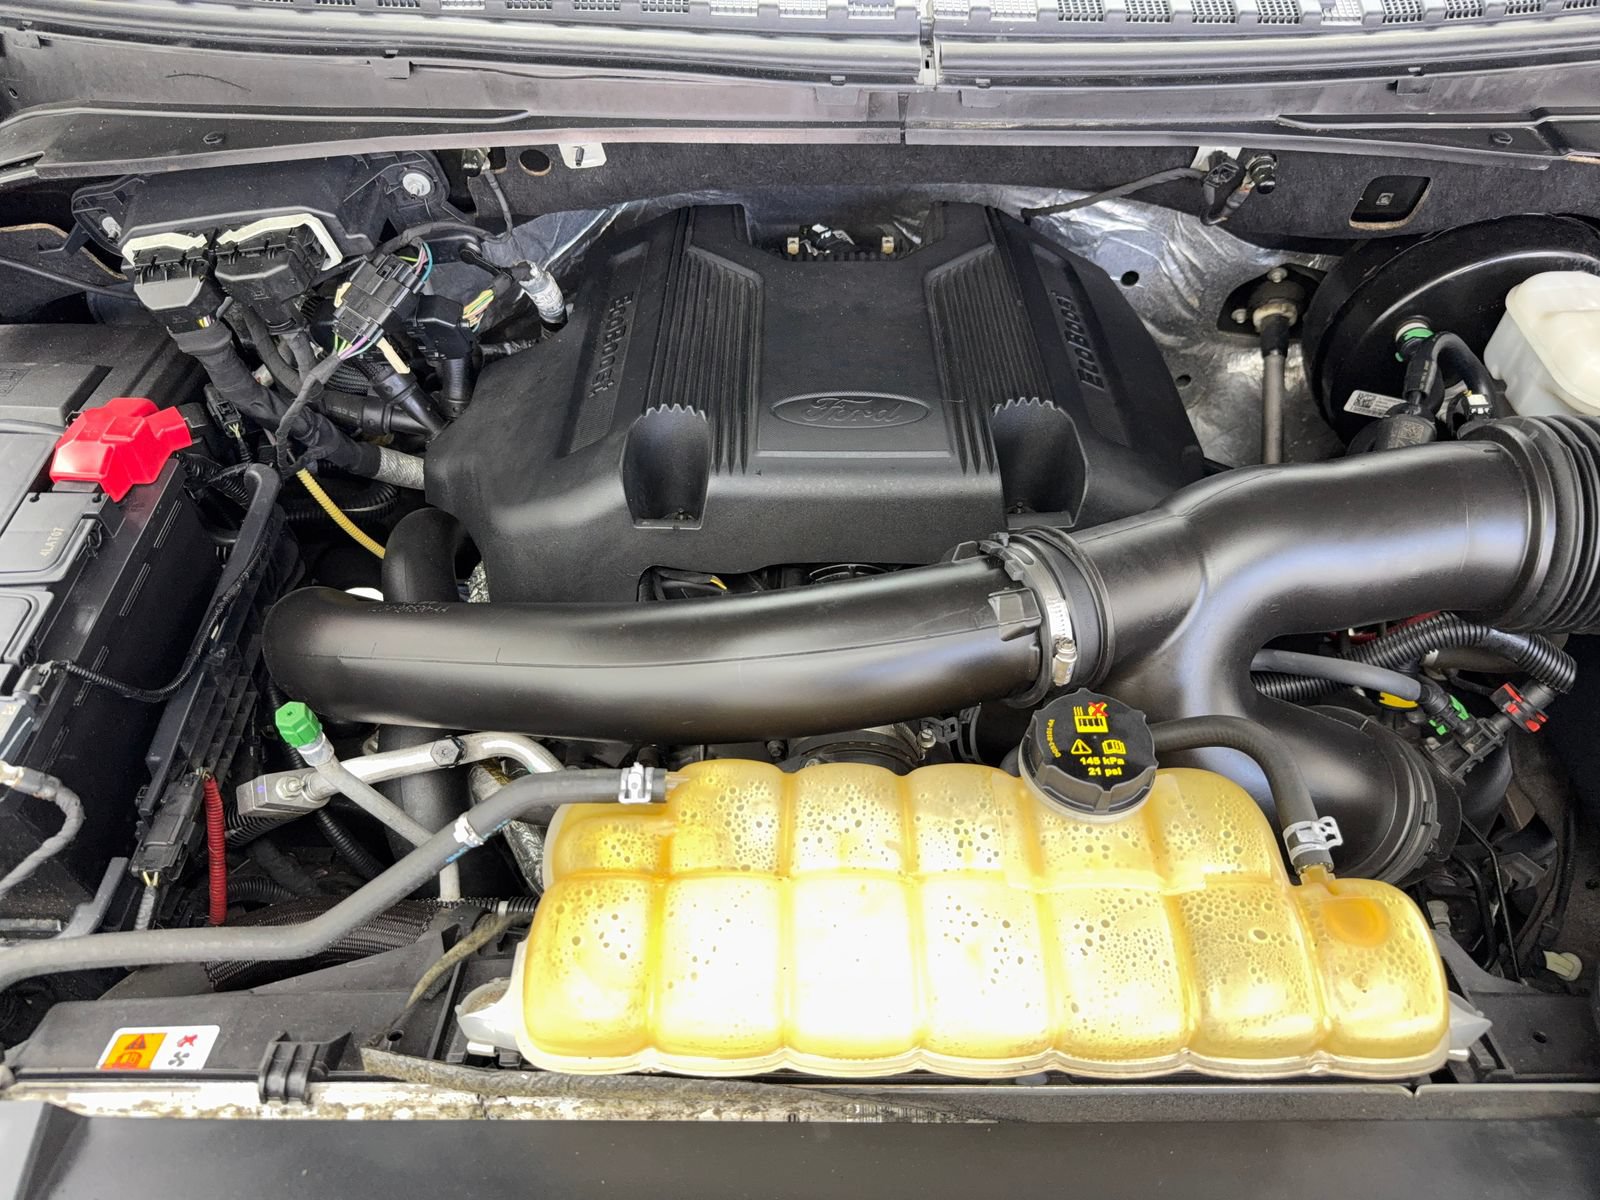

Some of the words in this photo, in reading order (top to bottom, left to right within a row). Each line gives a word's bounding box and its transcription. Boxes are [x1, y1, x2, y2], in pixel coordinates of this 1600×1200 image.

[588, 291, 634, 398] EcoBoost
[1050, 289, 1105, 392] EcoBoost
[800, 397, 903, 423] Ford
[1079, 757, 1101, 766] 145
[1102, 757, 1125, 766] kPa
[1087, 767, 1102, 776] 21
[1104, 767, 1123, 777] psi
